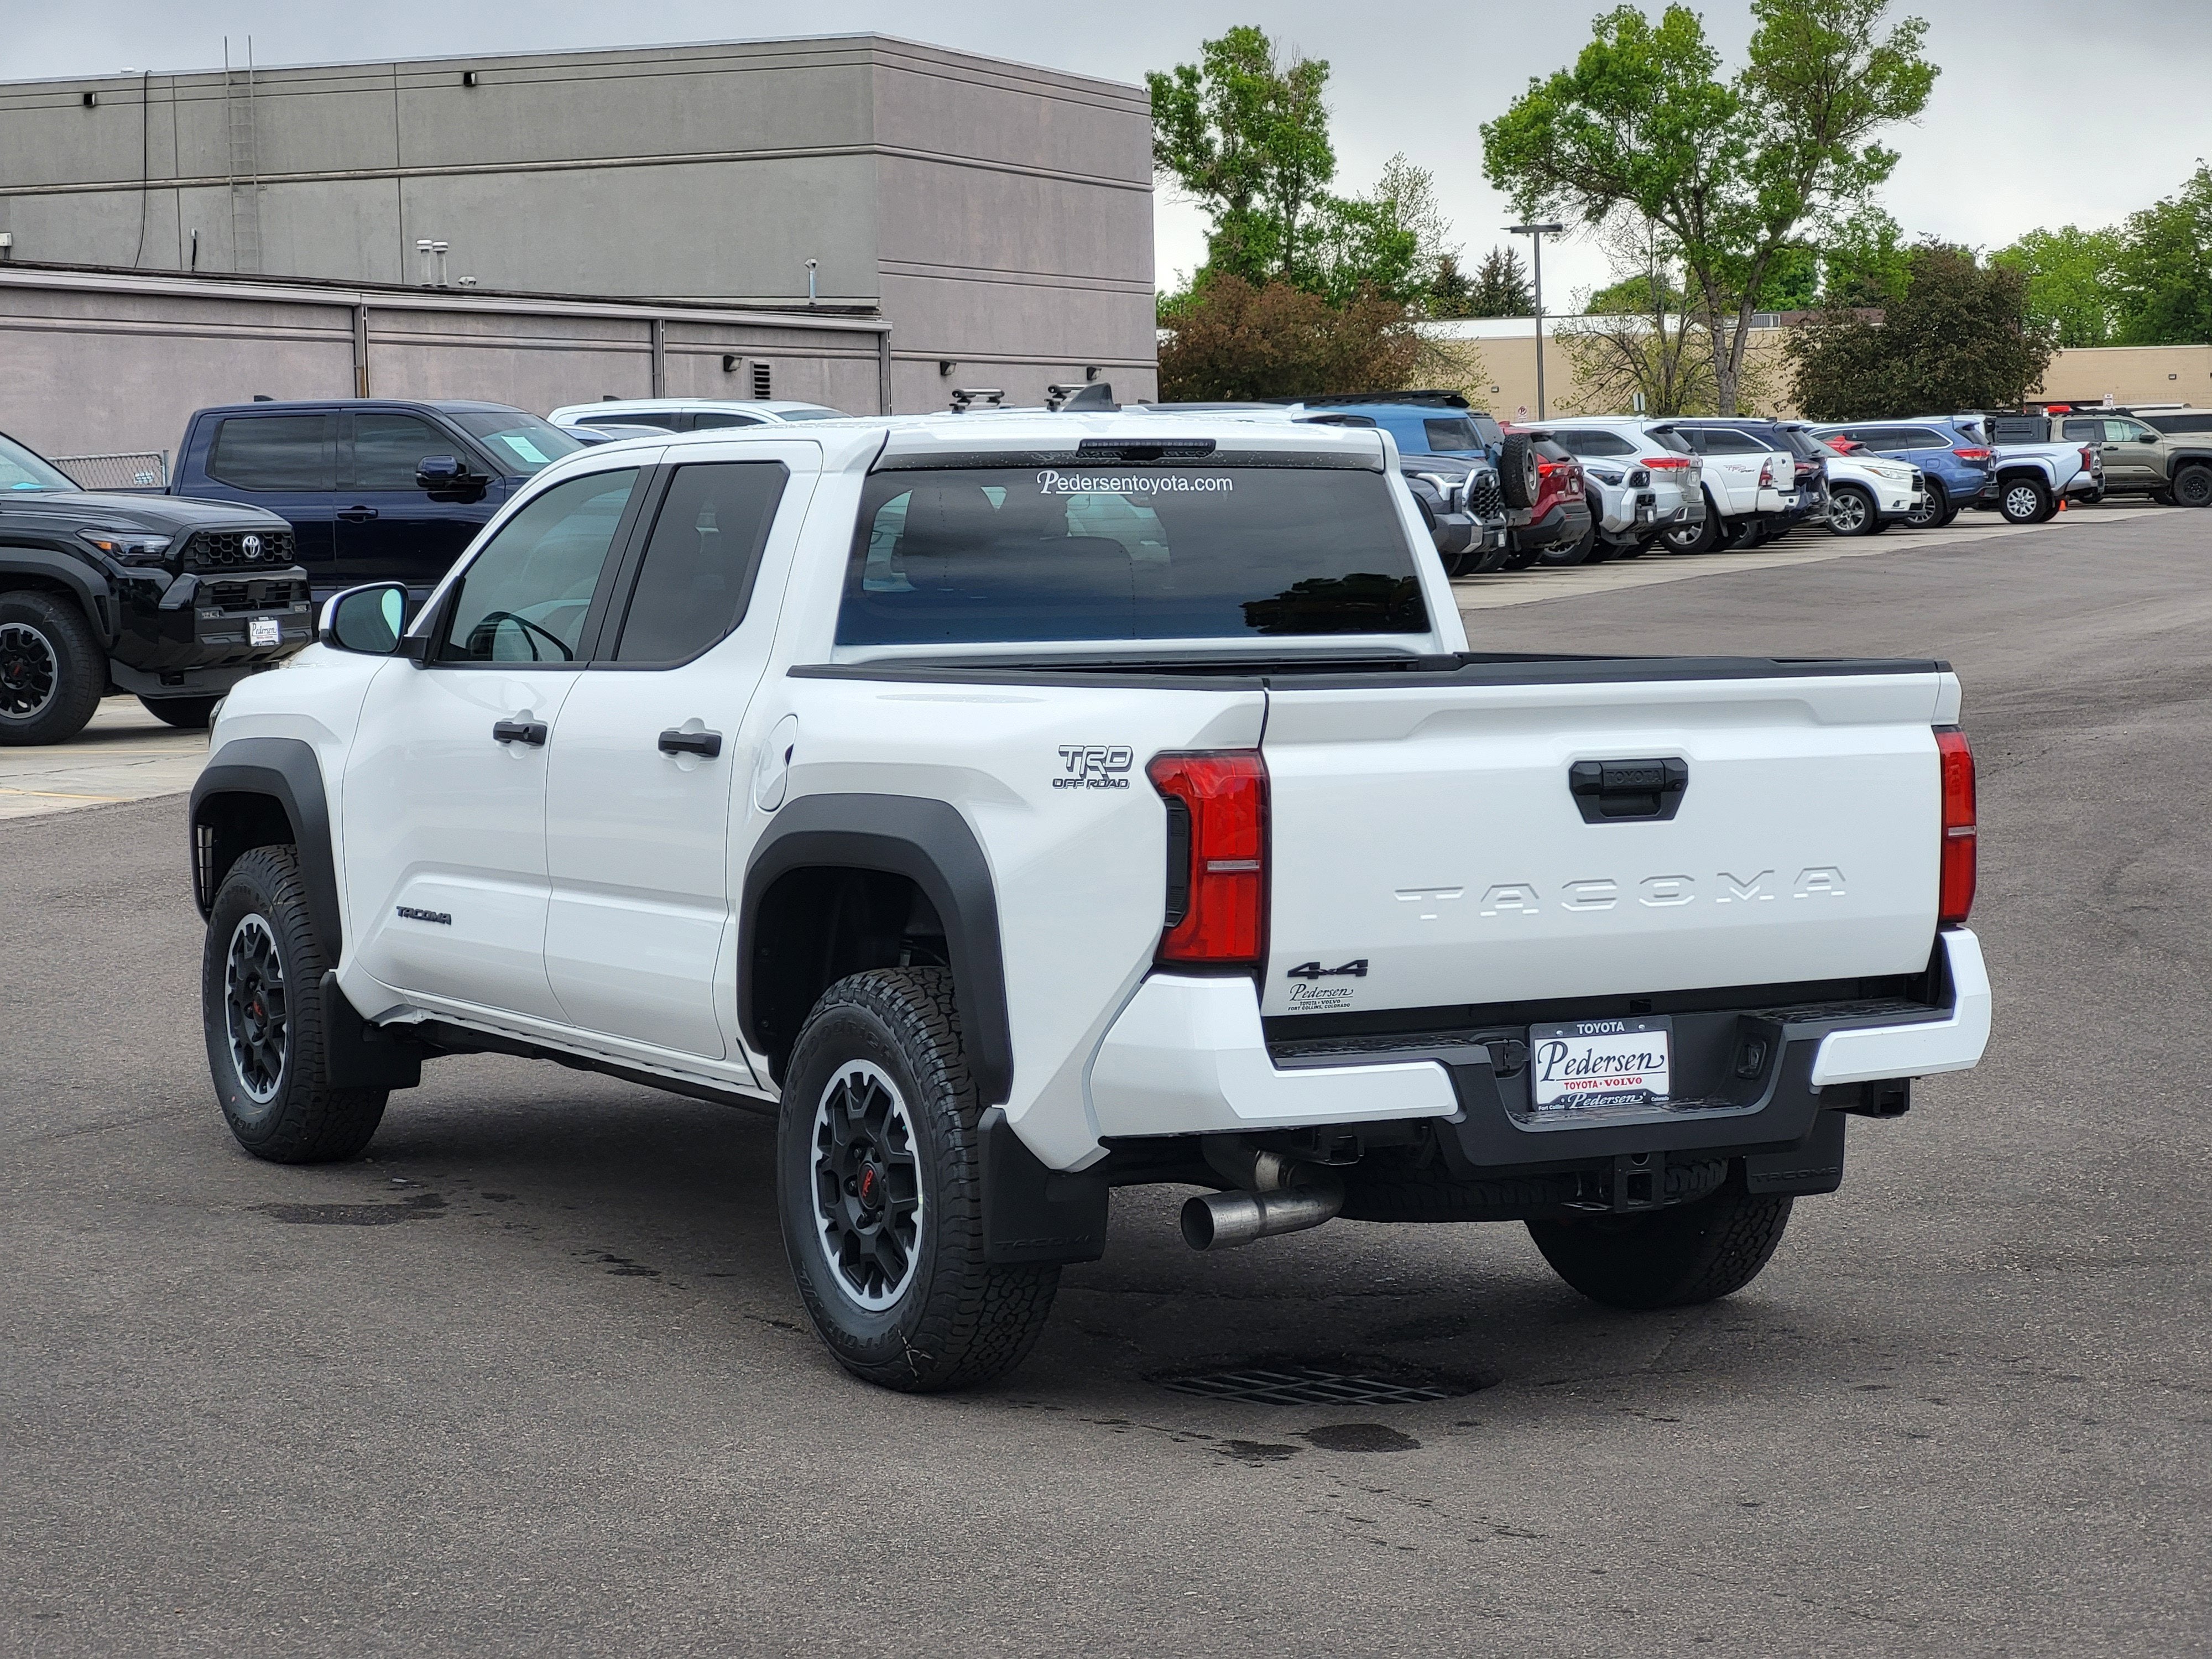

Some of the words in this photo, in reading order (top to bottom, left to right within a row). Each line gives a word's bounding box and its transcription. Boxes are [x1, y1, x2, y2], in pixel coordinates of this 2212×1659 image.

[1036, 469, 1234, 495] Pedersentoyota.com
[1058, 744, 1134, 780] TRD
[1052, 778, 1084, 789] OFF
[1086, 778, 1130, 789] ROAD
[1606, 770, 1662, 784] TOYOTA
[1394, 865, 1846, 920] TACOMA
[396, 905, 452, 925] TACOMA
[1289, 983, 1354, 1001] Pedersen
[1577, 1021, 1625, 1035] TOYOTA
[1537, 1040, 1665, 1082] Pedersen
[1564, 1080, 1598, 1091] TOYOTA
[1603, 1077, 1642, 1087] VOLVO
[1567, 1092, 1644, 1109] Pedersen
[1750, 1166, 1839, 1182] TACOMA
